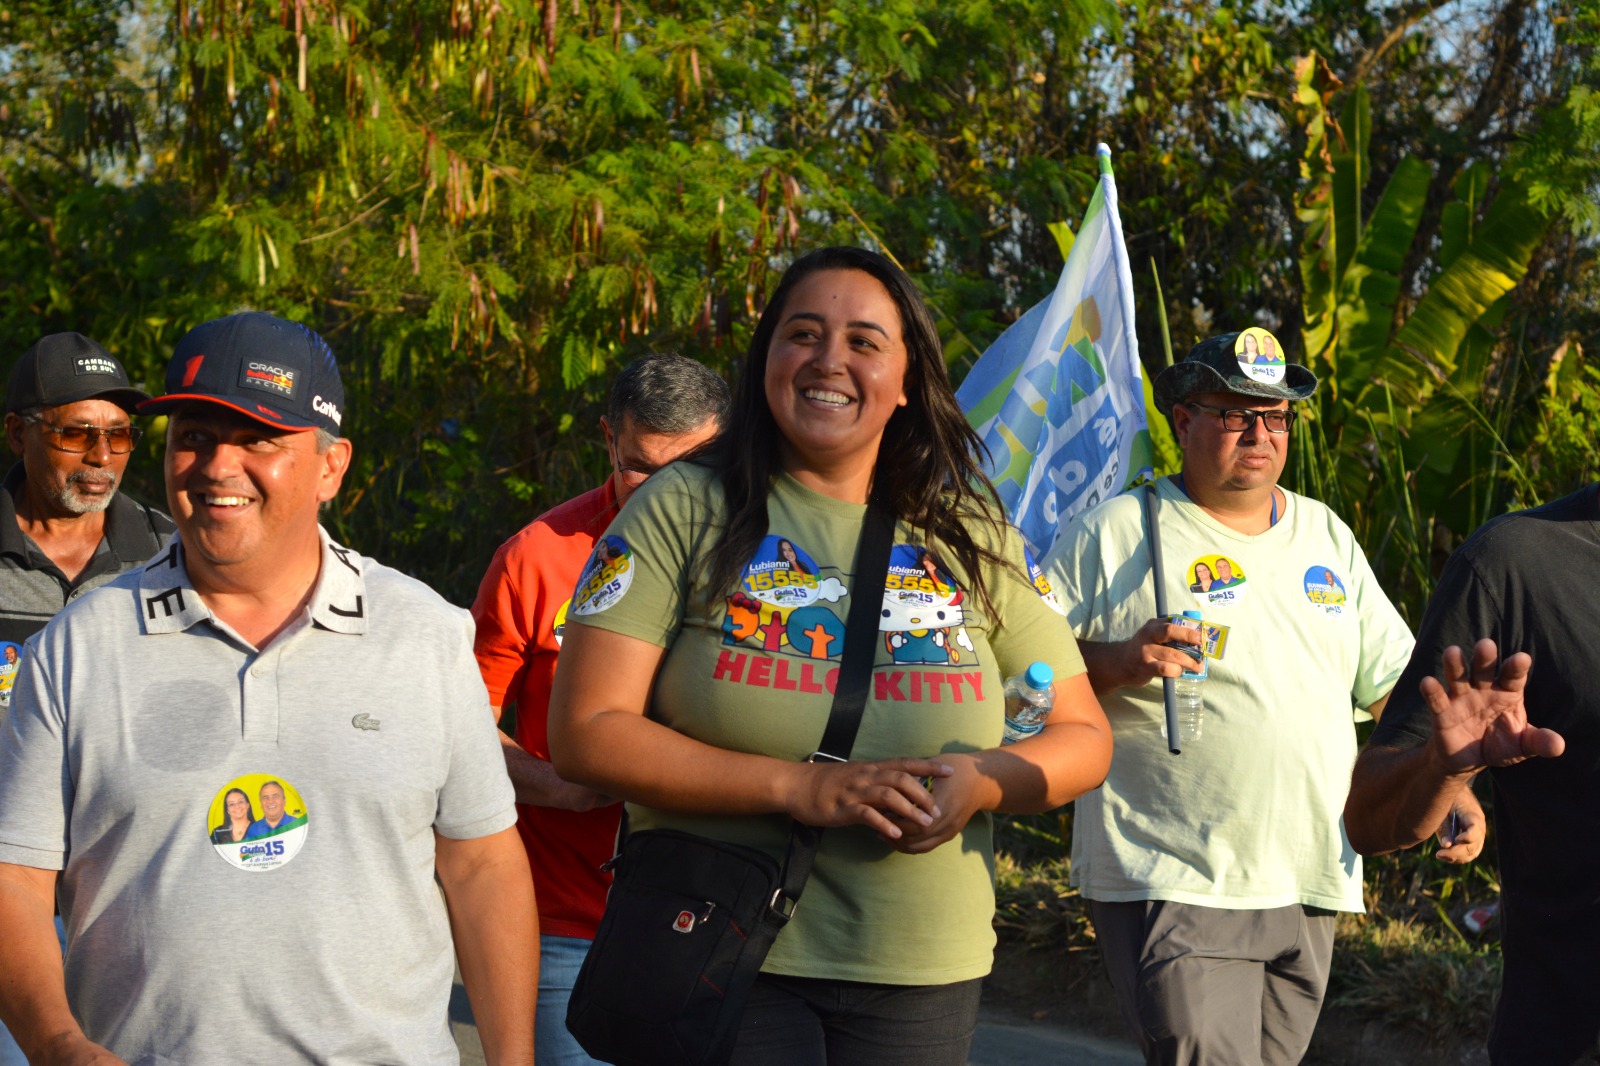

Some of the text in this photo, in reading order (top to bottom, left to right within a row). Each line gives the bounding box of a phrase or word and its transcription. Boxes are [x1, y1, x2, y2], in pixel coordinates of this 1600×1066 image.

[100, 365, 114, 373] SUL
[248, 362, 294, 381] ORACLE
[1266, 368, 1275, 377] 15
[246, 378, 292, 395] RACING
[749, 561, 790, 571] Lubianni
[888, 565, 926, 576] ubianni
[607, 578, 621, 595] 15
[745, 570, 818, 592] 15555
[885, 574, 951, 598] 5555
[774, 589, 794, 598] Guto
[793, 588, 808, 599] 15
[899, 591, 919, 599] Guto
[918, 593, 934, 604] 15
[1223, 590, 1235, 600] 15
[874, 671, 983, 704] KITTY
[240, 840, 284, 856] Guto 15
